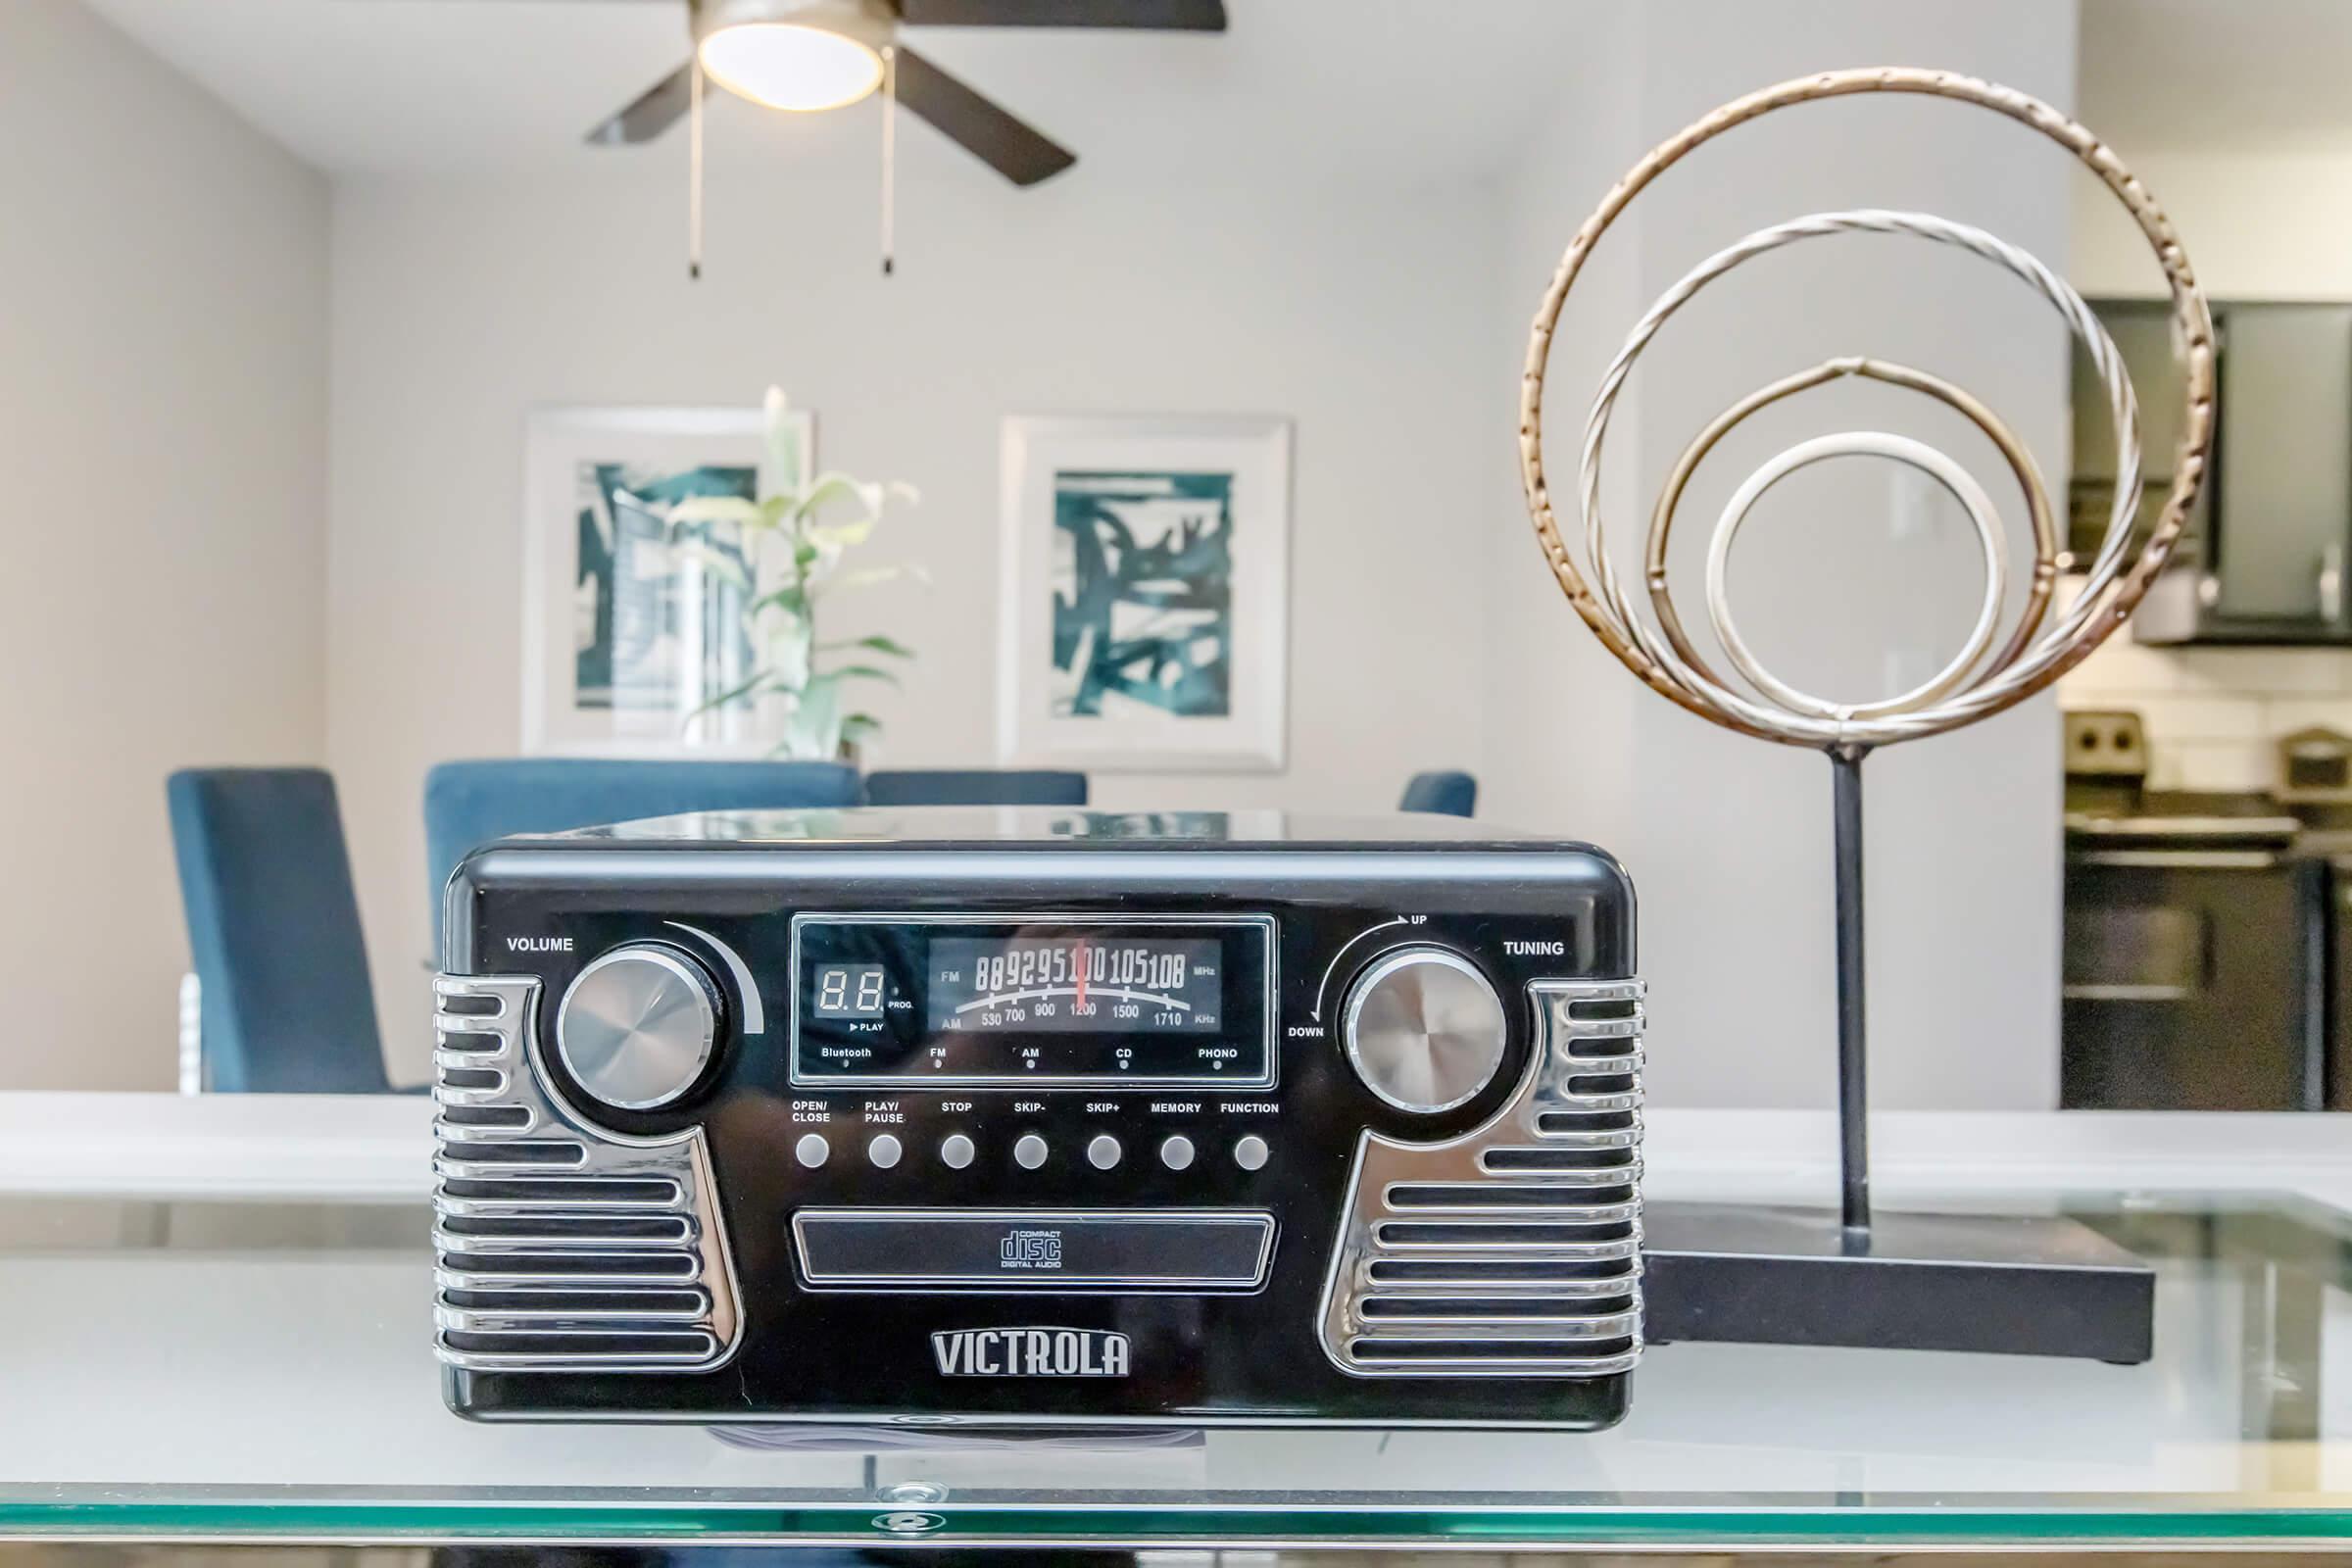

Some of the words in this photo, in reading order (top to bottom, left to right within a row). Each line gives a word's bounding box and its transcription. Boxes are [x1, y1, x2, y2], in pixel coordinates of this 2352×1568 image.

[1411, 915, 1427, 924] UP
[507, 938, 573, 951] VOLUME
[1503, 941, 1564, 956] TUNING
[941, 971, 959, 982] FM
[975, 956, 1004, 991] 88
[1006, 951, 1035, 985] 92
[1038, 948, 1065, 983] 95
[1068, 947, 1105, 982] 100
[1109, 949, 1148, 984] 105
[1148, 954, 1186, 989] 108
[1194, 966, 1215, 976] MHz
[942, 1018, 961, 1029] AM
[981, 1012, 1002, 1026] 530
[1004, 1008, 1026, 1022] 700
[1036, 1003, 1055, 1016] 900
[1070, 1003, 1097, 1015] 1200
[1113, 1004, 1139, 1018] 1500
[1154, 1012, 1182, 1026] 1710
[1195, 1014, 1215, 1024] KHz
[859, 1023, 884, 1032] PLAY
[1289, 1027, 1323, 1037] DOWN
[821, 1048, 871, 1057] Bluetooth
[930, 1048, 946, 1057] FM
[1022, 1048, 1040, 1057] AM
[1115, 1049, 1132, 1058] CD
[1198, 1049, 1238, 1058] PHONO
[792, 1101, 827, 1111] OPEN/
[864, 1102, 899, 1111] PLAY/
[941, 1102, 972, 1112] STOP
[1014, 1102, 1046, 1112] SKIP-
[1086, 1102, 1120, 1113] SKIP+
[1151, 1102, 1201, 1113] MEMORY
[1220, 1102, 1279, 1113] FUNCTION
[792, 1112, 830, 1122] CLOSE
[864, 1113, 904, 1123] PAUSE
[933, 1330, 1128, 1375] VICTROLA
